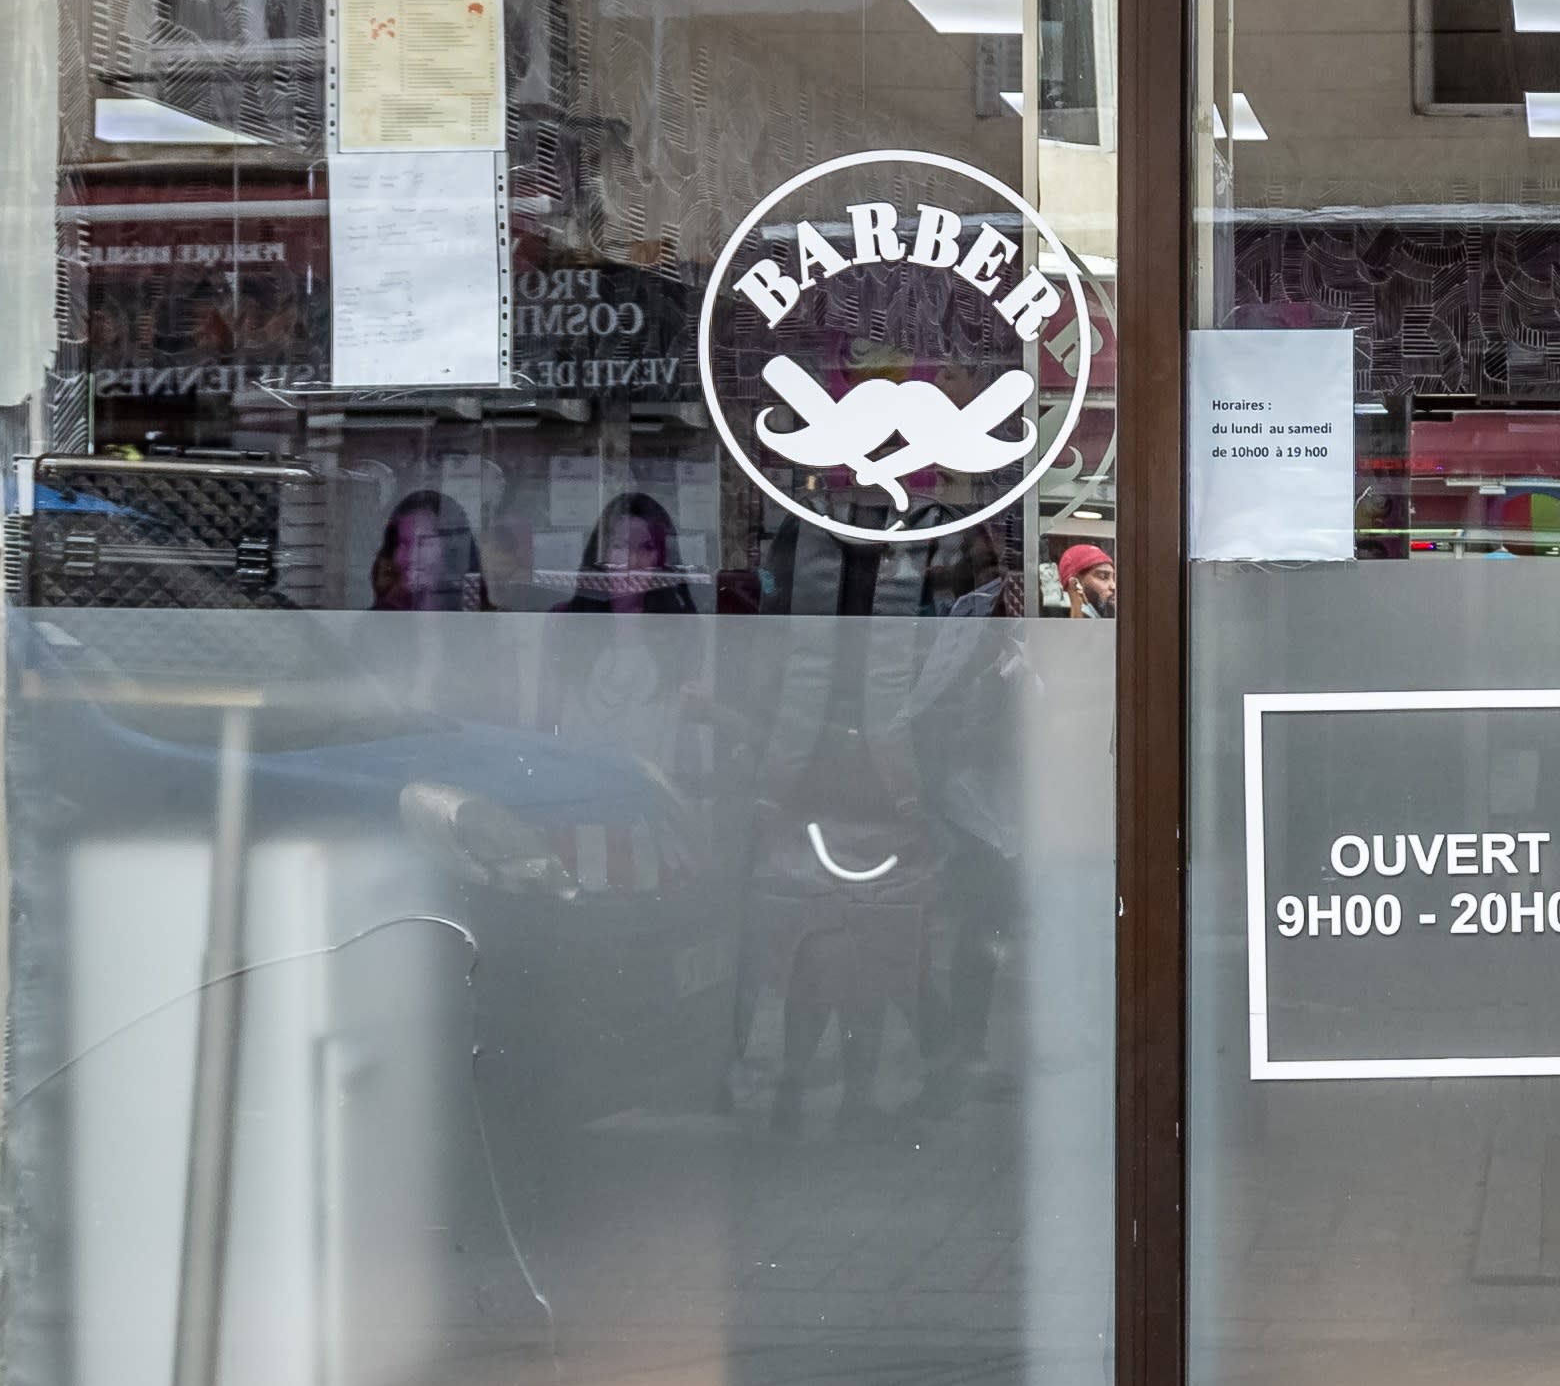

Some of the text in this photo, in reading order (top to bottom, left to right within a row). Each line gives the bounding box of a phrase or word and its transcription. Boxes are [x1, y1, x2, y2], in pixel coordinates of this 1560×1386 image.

[732, 201, 1062, 343] BARBER
[1211, 399, 1265, 411] Horaires
[1211, 423, 1333, 435] du lundi au samedi
[1211, 445, 1328, 458] de 10h00 à 19 h00
[1330, 832, 1551, 877] OUVERT
[1276, 894, 1402, 937] 9H00
[1419, 914, 1436, 924] -
